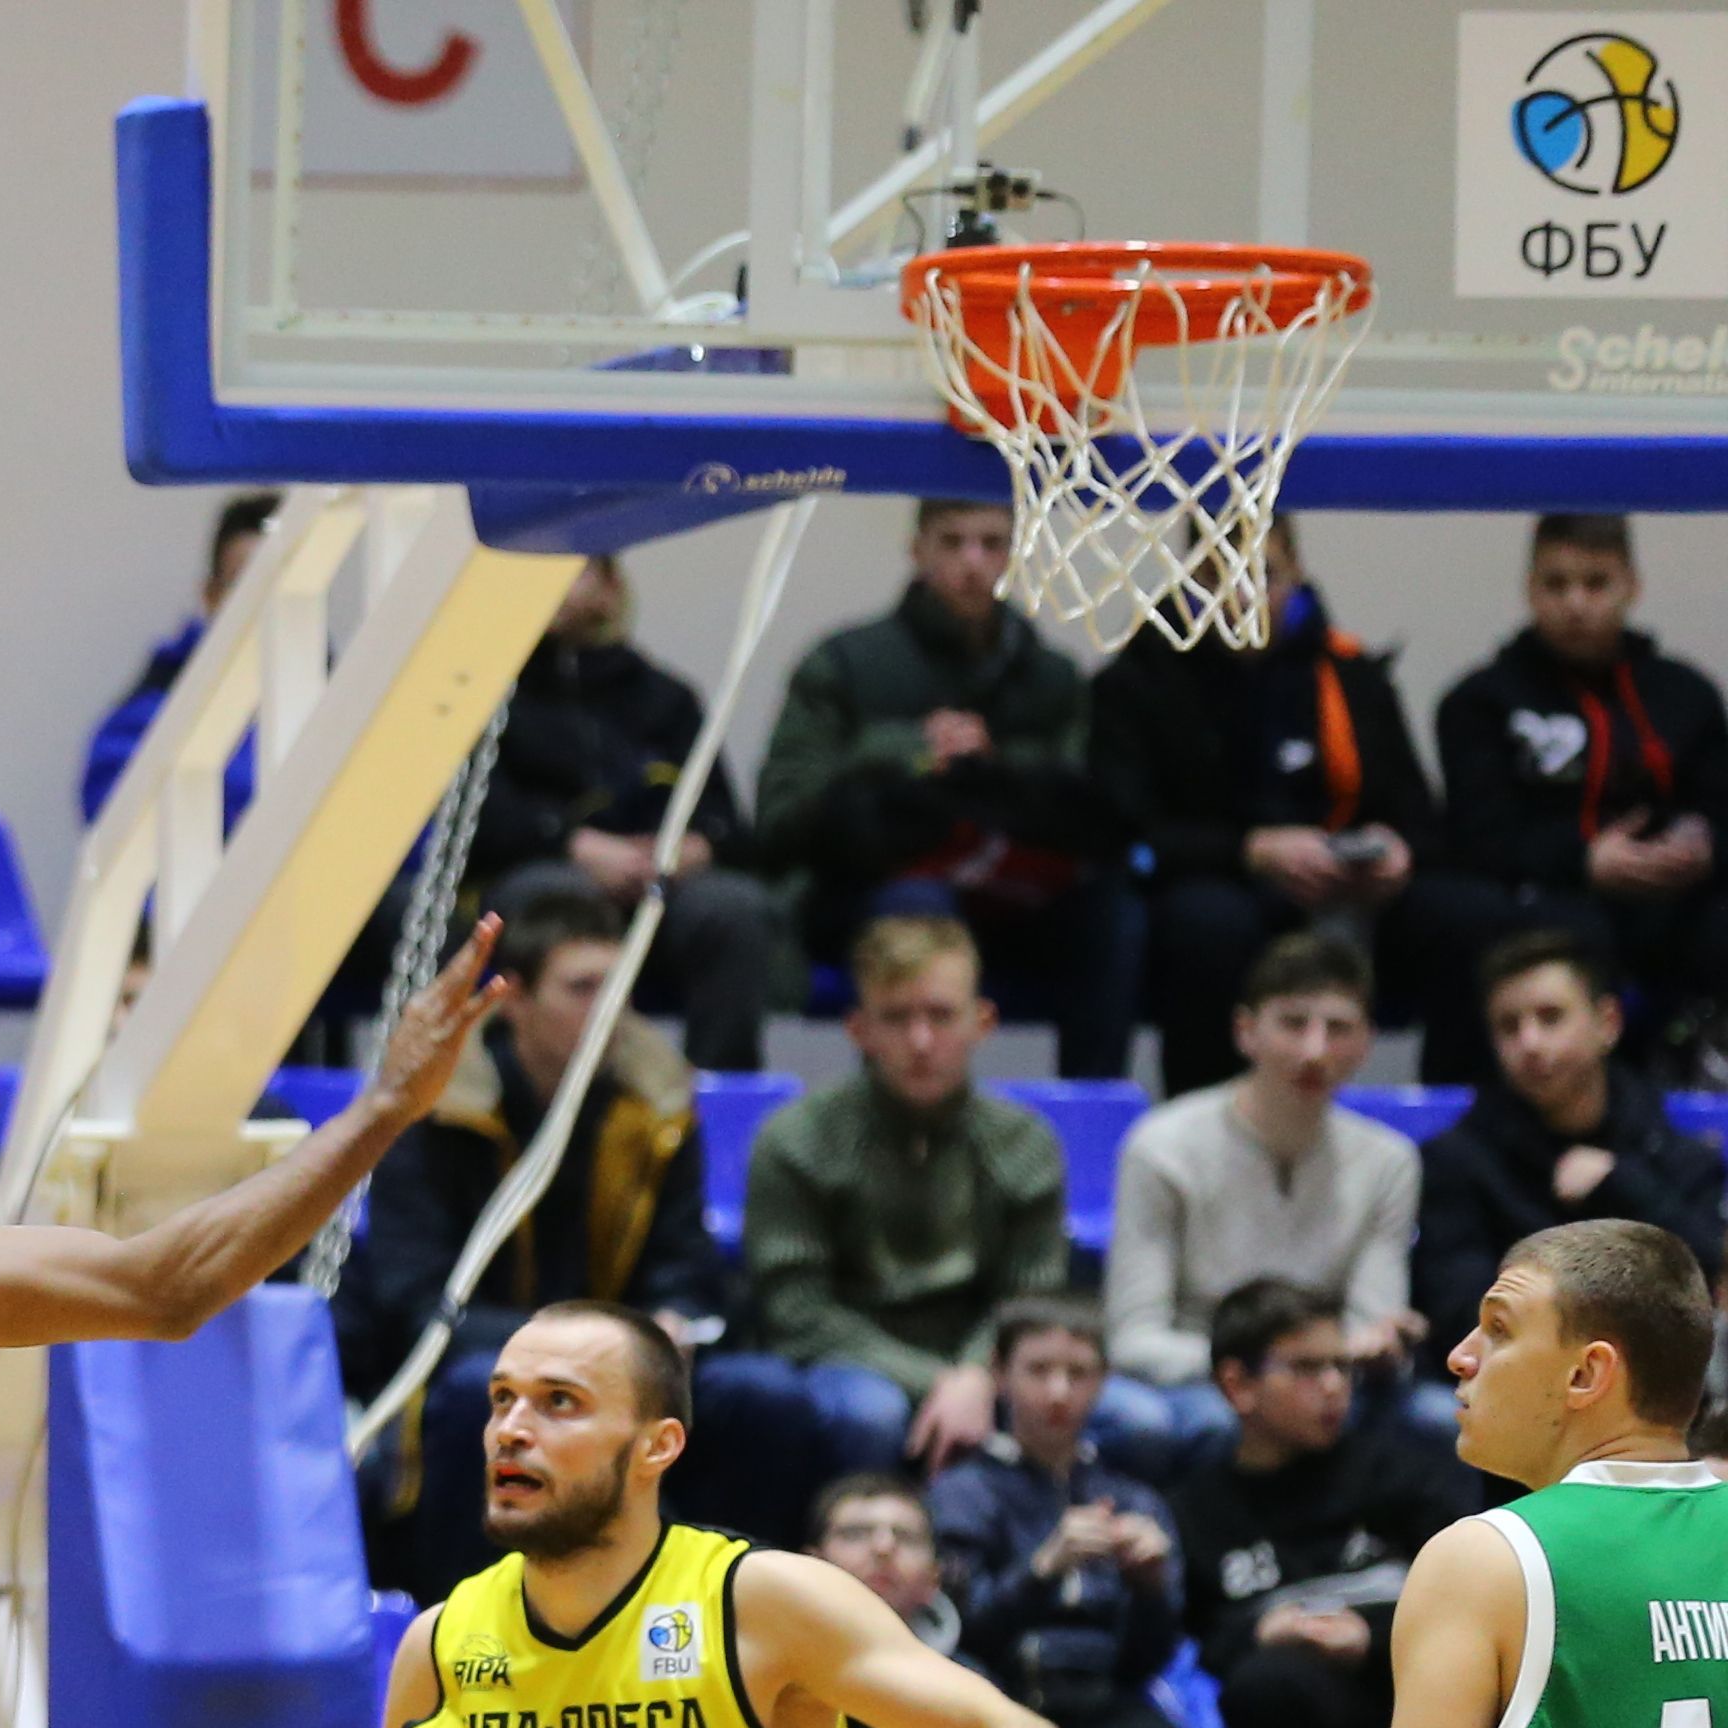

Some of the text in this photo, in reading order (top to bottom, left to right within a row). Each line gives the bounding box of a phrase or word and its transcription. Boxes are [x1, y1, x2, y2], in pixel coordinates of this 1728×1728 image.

[1521, 220, 1668, 279] ФБУ
[1548, 323, 1728, 391] Schel
[653, 1657, 692, 1675] FBU
